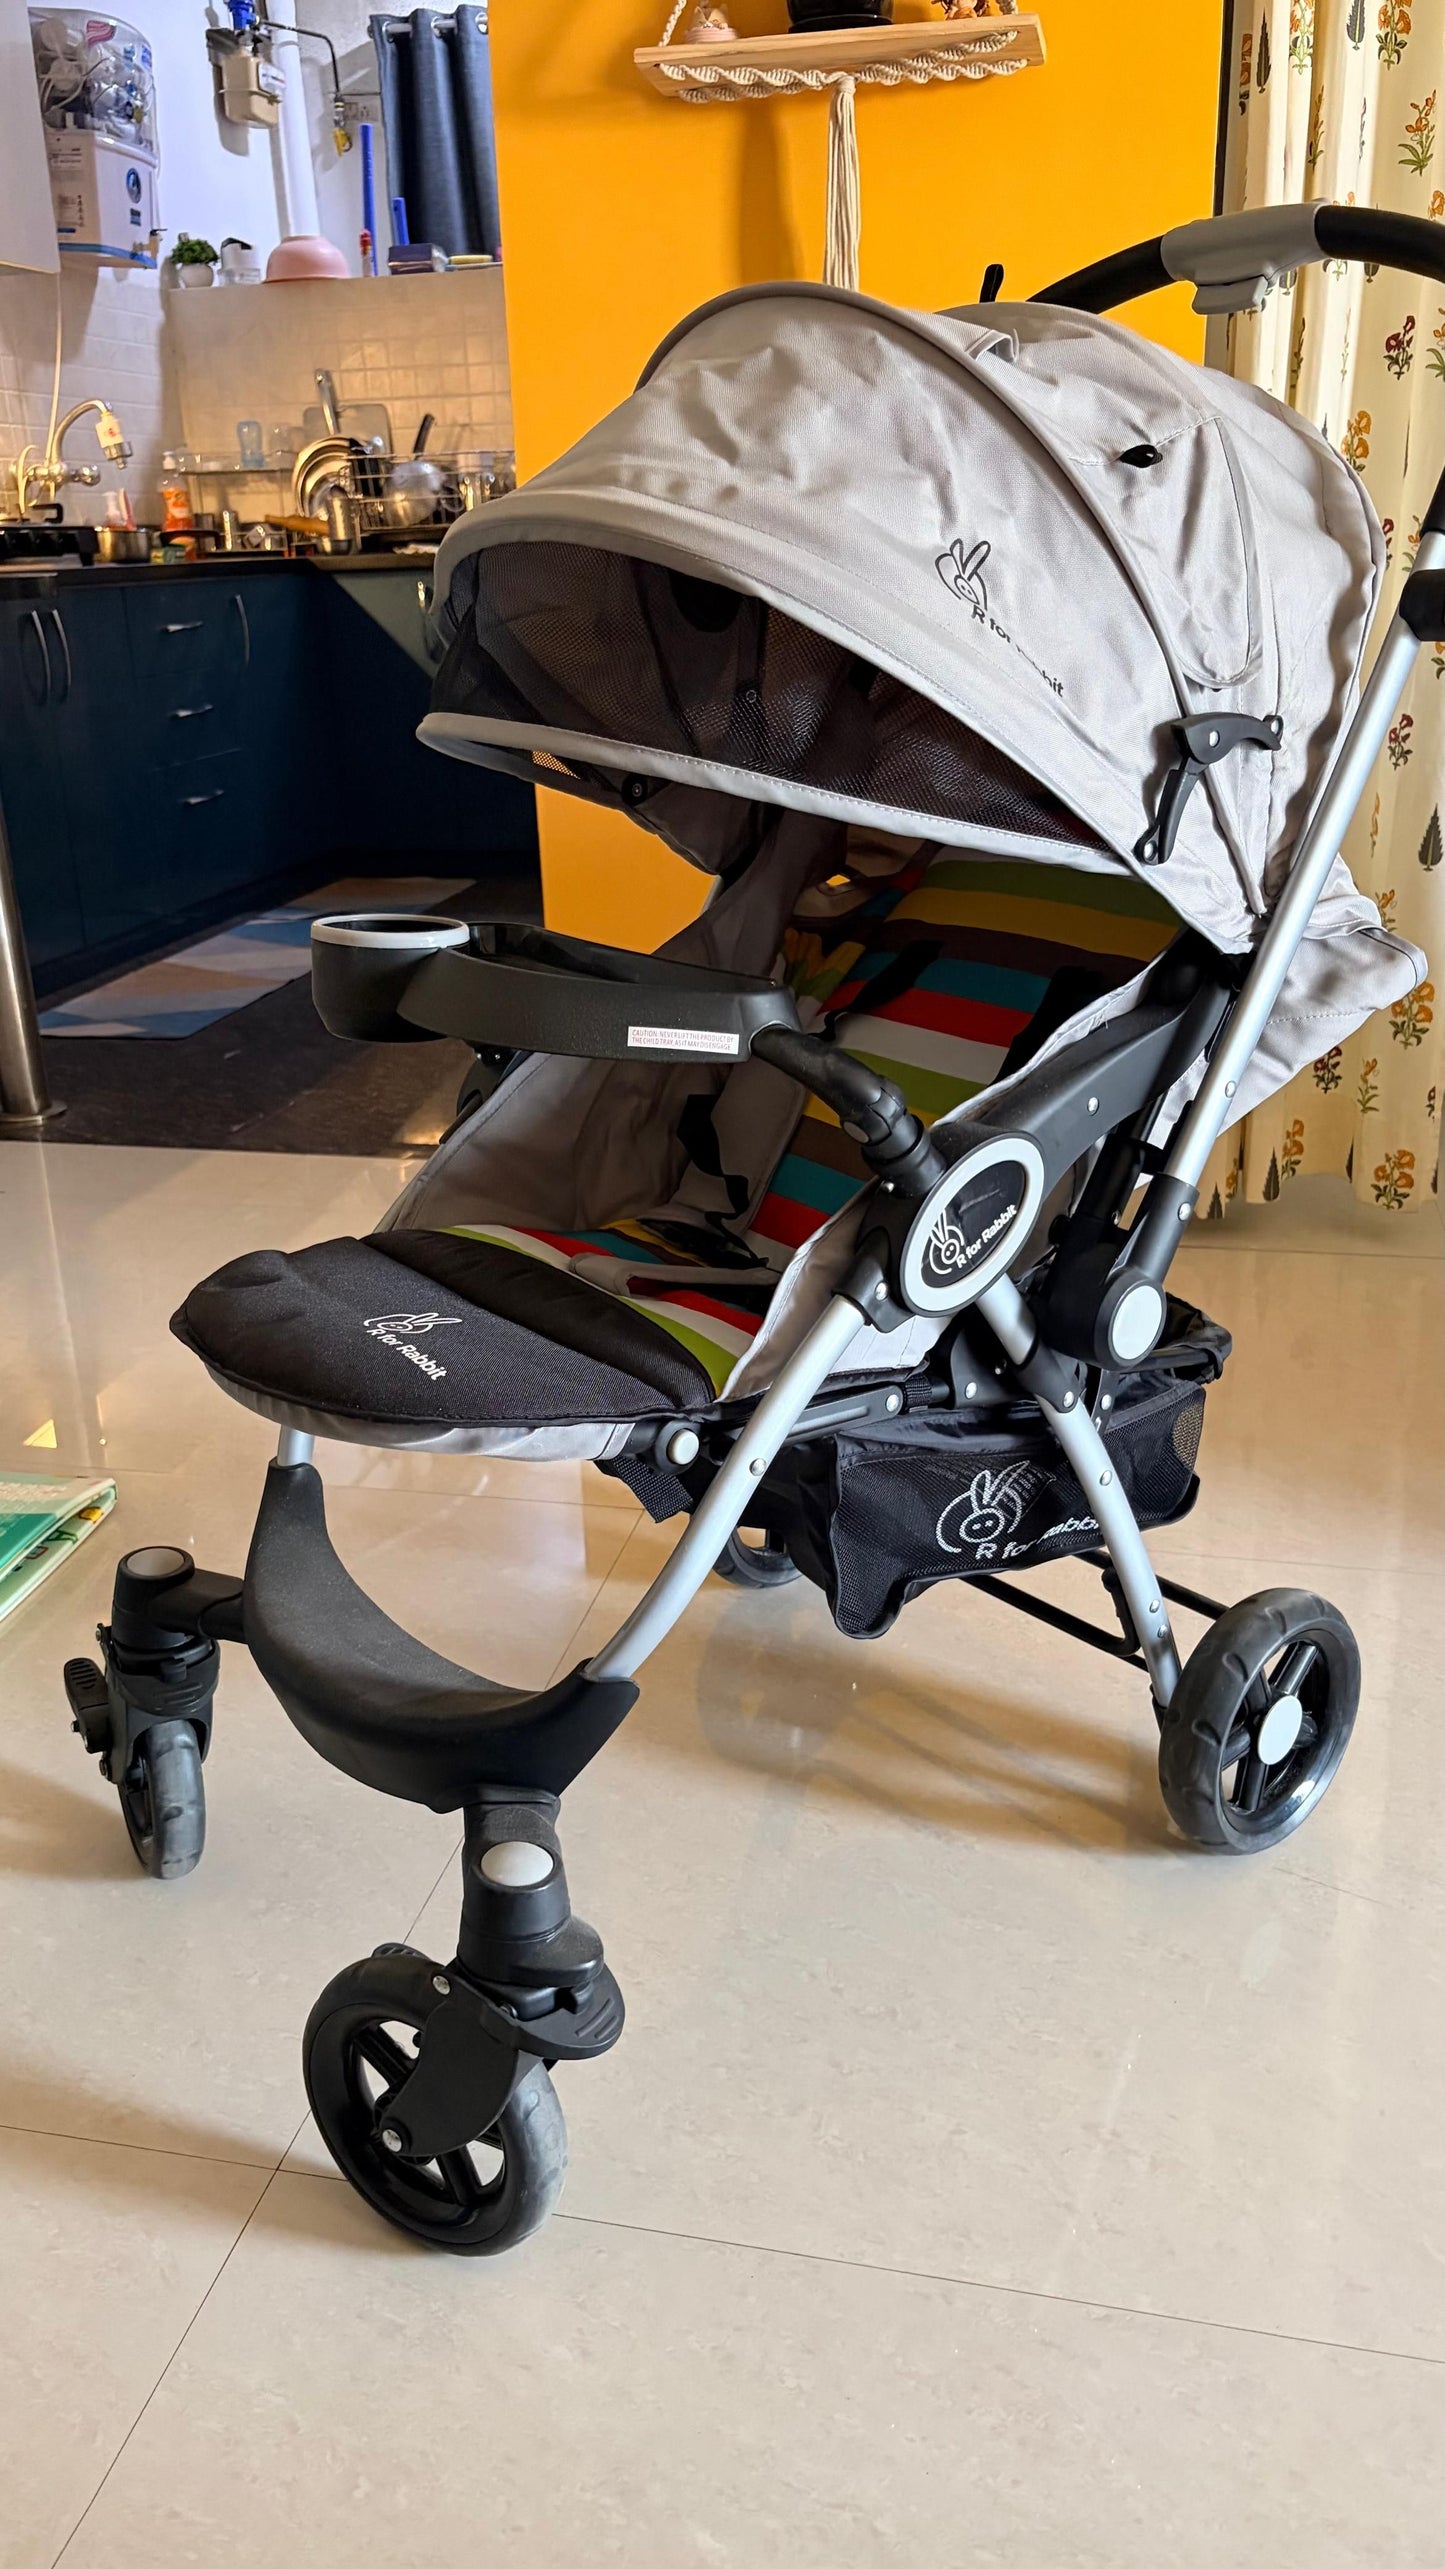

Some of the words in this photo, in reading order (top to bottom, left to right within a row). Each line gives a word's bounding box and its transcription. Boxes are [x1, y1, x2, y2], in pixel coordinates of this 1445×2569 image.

[971, 605, 985, 624] R
[632, 1037, 642, 1045] THE
[642, 1037, 659, 1045] CHILD
[687, 1040, 699, 1048] MAY
[660, 1030, 677, 1039] NEVER
[700, 1033, 727, 1042] PRODUCT
[956, 1254, 967, 1268] R
[966, 1239, 981, 1259] for
[981, 1204, 1016, 1242] Rabbit
[366, 1328, 387, 1336] R
[377, 1334, 404, 1346] for
[396, 1344, 448, 1381] Rabbit
[975, 1542, 998, 1560] R
